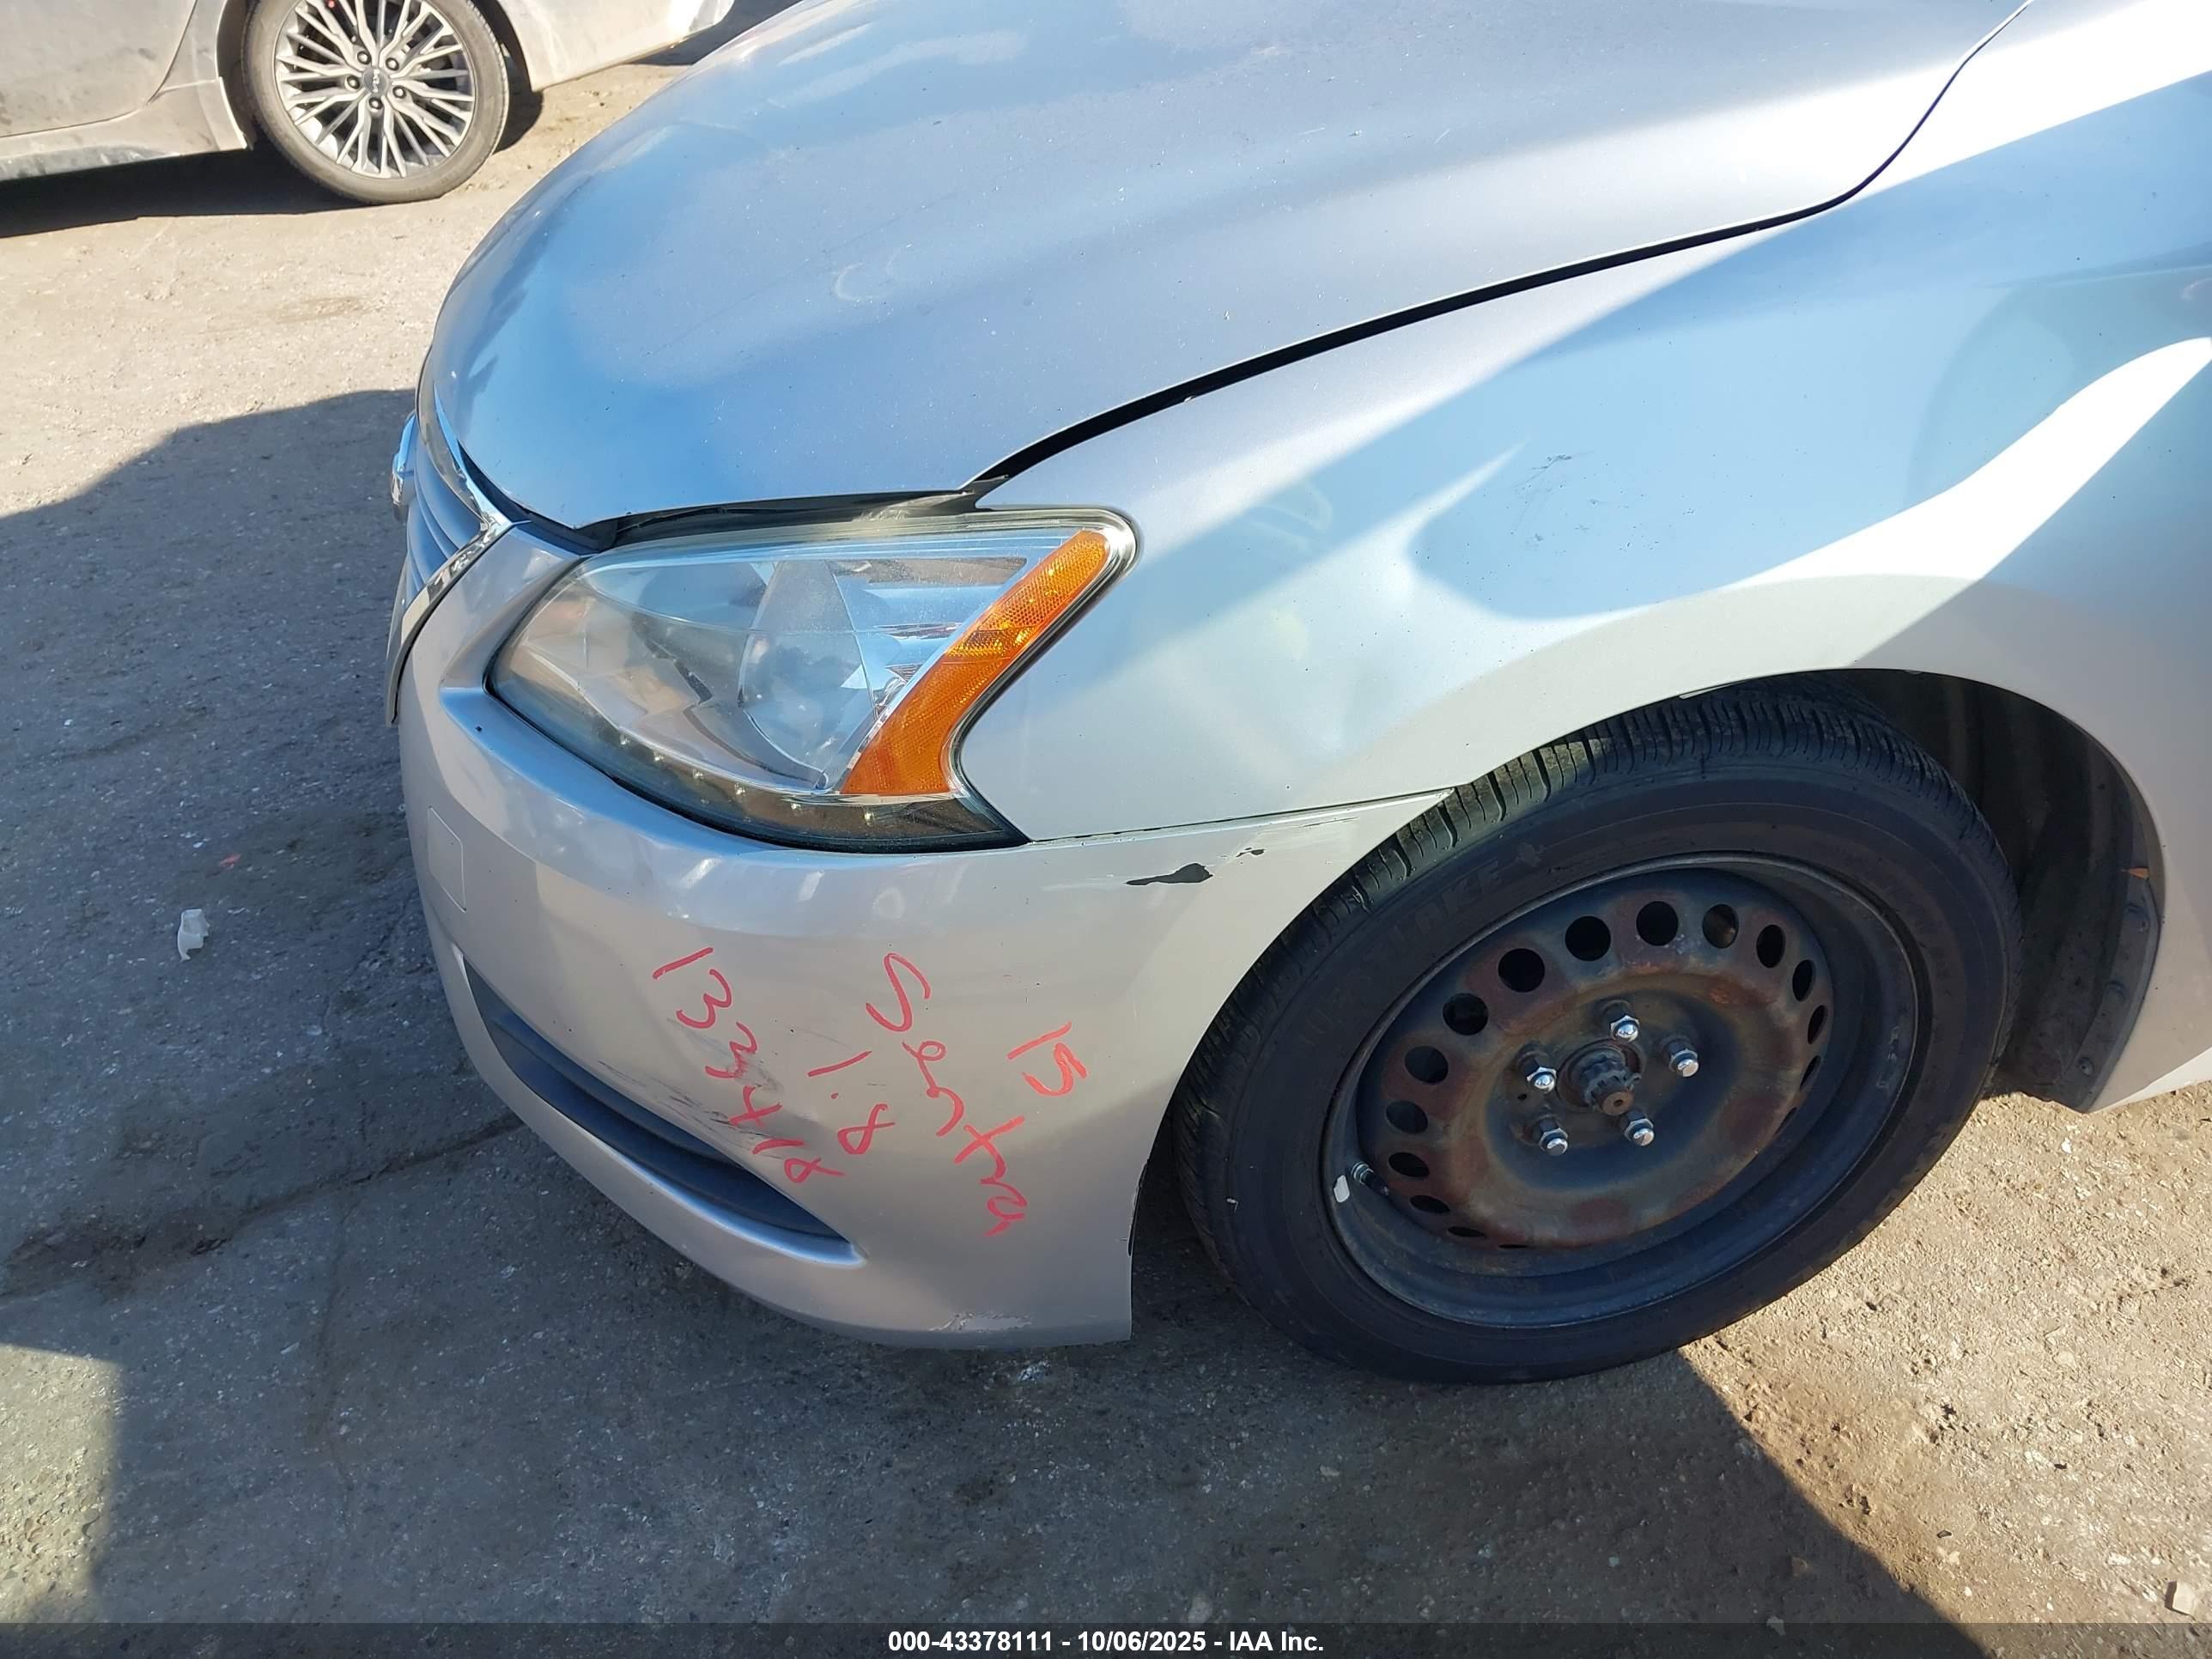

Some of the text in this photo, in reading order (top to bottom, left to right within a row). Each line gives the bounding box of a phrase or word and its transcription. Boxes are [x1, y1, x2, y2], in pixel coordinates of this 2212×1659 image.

[805, 1049, 896, 1156] 1.8
[865, 951, 1029, 1237] Sentra
[1006, 1020, 1090, 1097] 15
